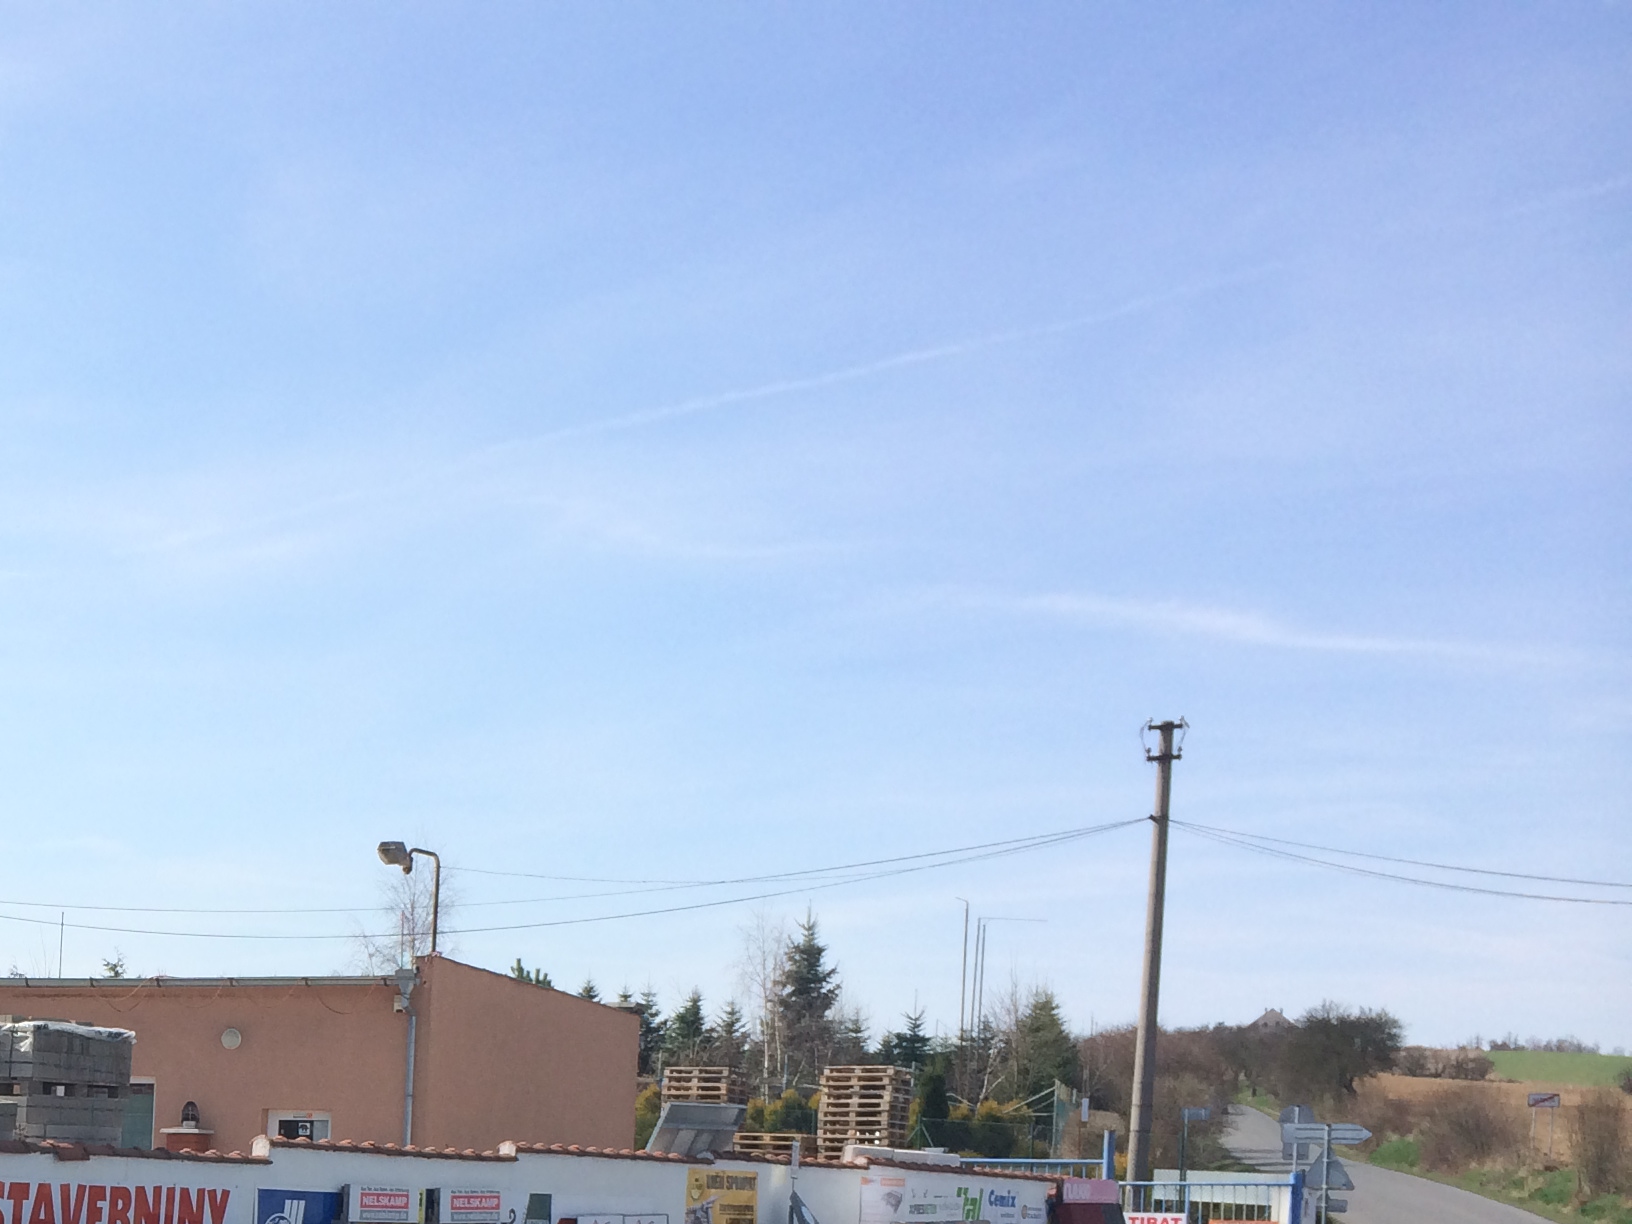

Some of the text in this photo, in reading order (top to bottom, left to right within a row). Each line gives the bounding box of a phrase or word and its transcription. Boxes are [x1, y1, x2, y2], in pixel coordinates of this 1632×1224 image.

[362, 1195, 408, 1207] NELSKAMP
[452, 1197, 498, 1208] NELSKAMP
[988, 1189, 1016, 1208] Cemix
